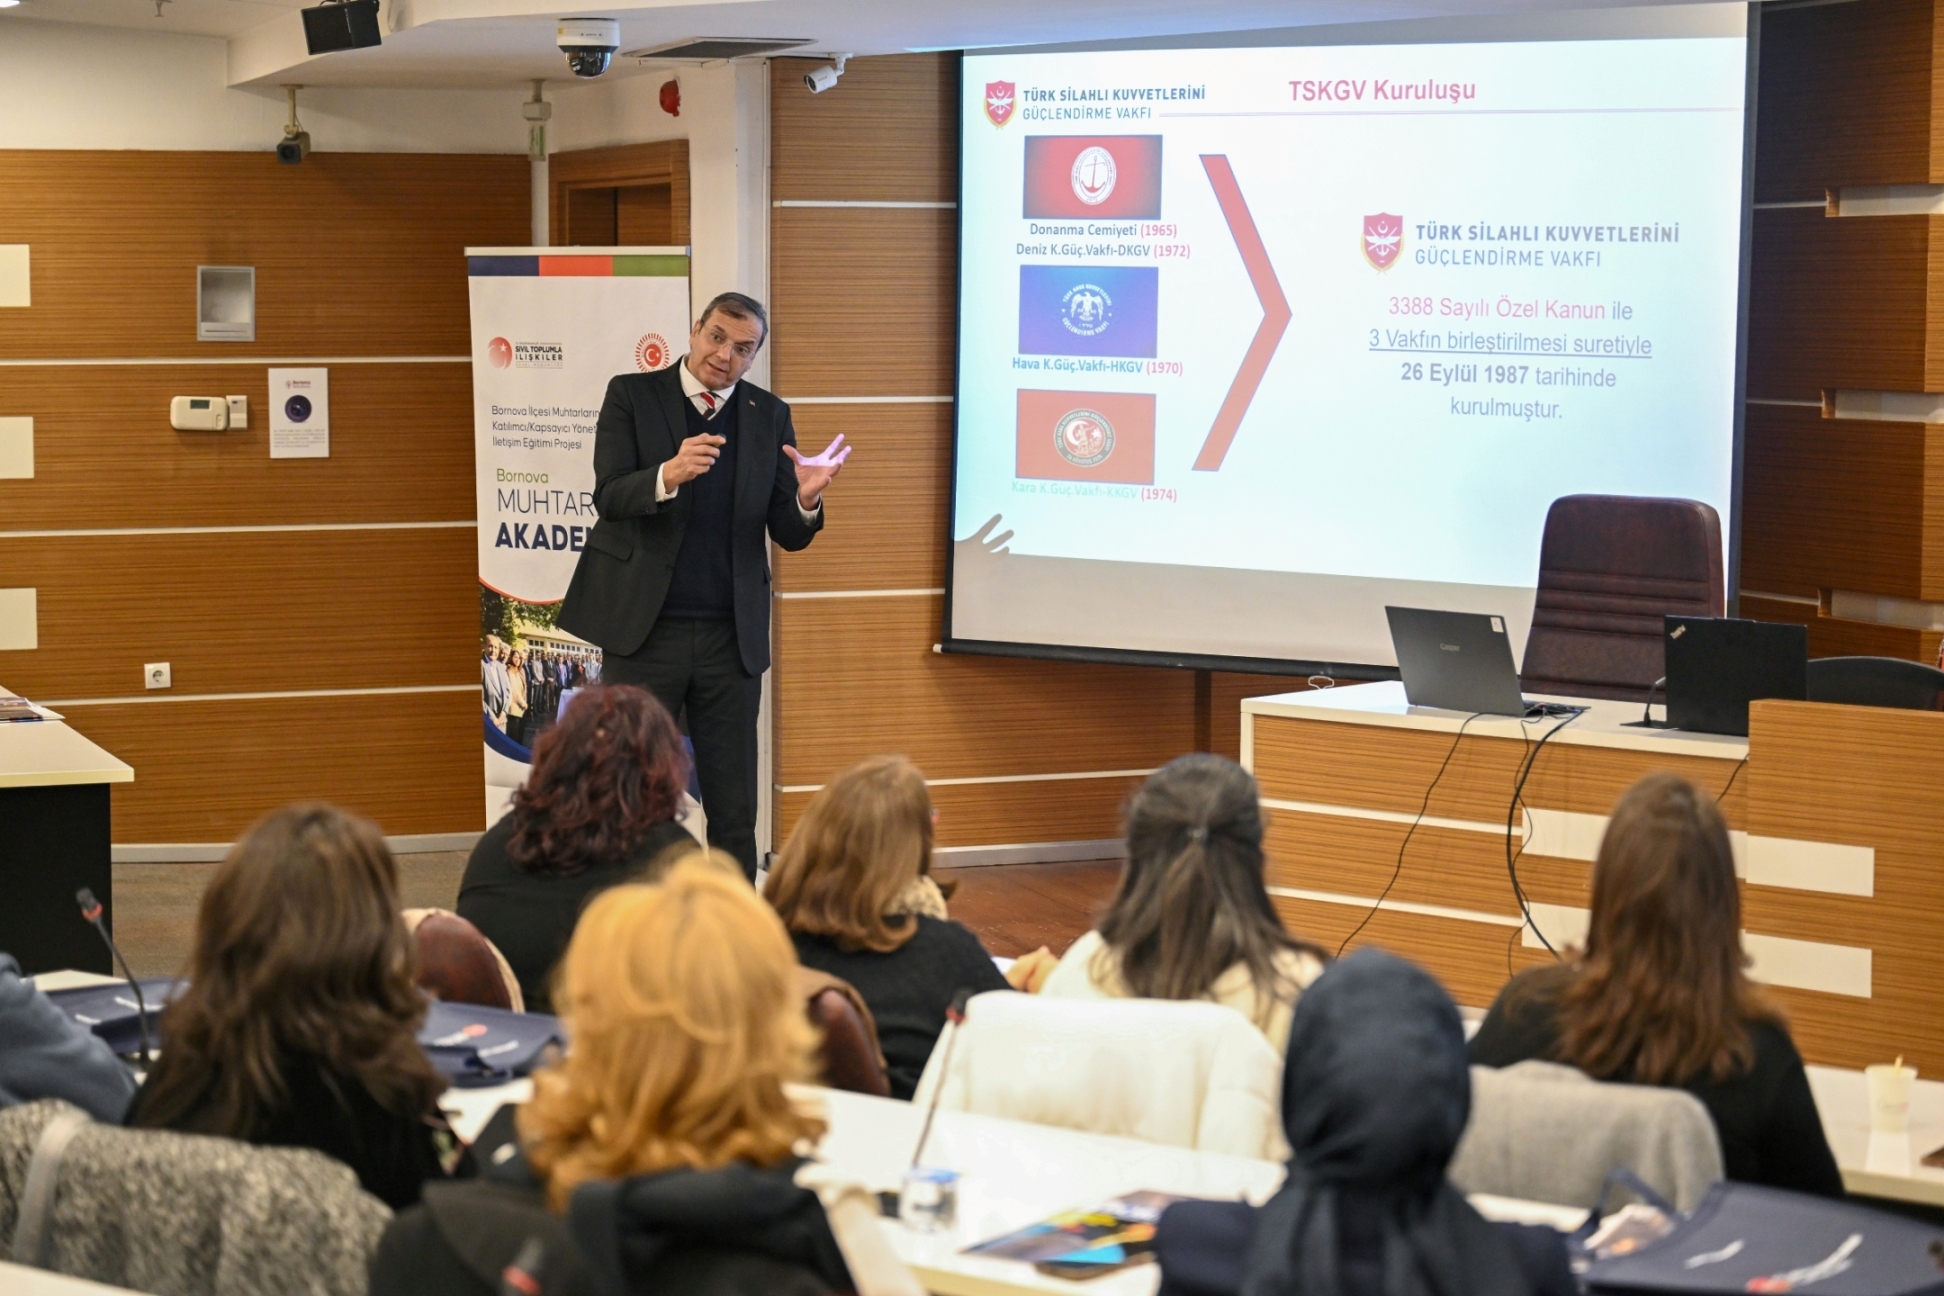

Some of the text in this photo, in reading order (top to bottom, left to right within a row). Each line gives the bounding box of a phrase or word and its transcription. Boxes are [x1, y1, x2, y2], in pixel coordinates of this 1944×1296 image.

[1023, 84, 1206, 102] TÜRK SİLAHLI KUVVETLERİNİ
[1289, 79, 1476, 104] TSKGV Kuruluşu
[1022, 105, 1152, 121] GÜÇLENDİRME VAKFI
[1030, 223, 1178, 238] Donanma Cemiyeti (1965)
[1416, 221, 1680, 242] TÜRK SİLAHLI KUVVETLERİNİ
[1016, 243, 1190, 260] Deniz K.Güç.Vakfı-DKGV (1972)
[1416, 246, 1600, 267] GÜÇLENDİRME VAKFI
[1389, 294, 1633, 321] 3388 Sayılı Özel Kanun ile
[1369, 328, 1652, 358] 3 Vakfın birleştirilmesi suretiyle
[1012, 358, 1183, 377] Hava K.Güç.Vakfı-HKGV (1970)
[1401, 362, 1617, 387] 26 Eylül 1987 tarihinde
[492, 405, 527, 416] Bornova
[528, 405, 550, 418] İlçesi
[1451, 396, 1562, 422] kurulmuştur.
[492, 435, 582, 451] İletişim Eğitimi Projesi
[497, 468, 549, 483] Bornova
[498, 488, 599, 516] MUHTAR
[1012, 481, 1036, 493] Kara
[1141, 487, 1177, 503] (1974)
